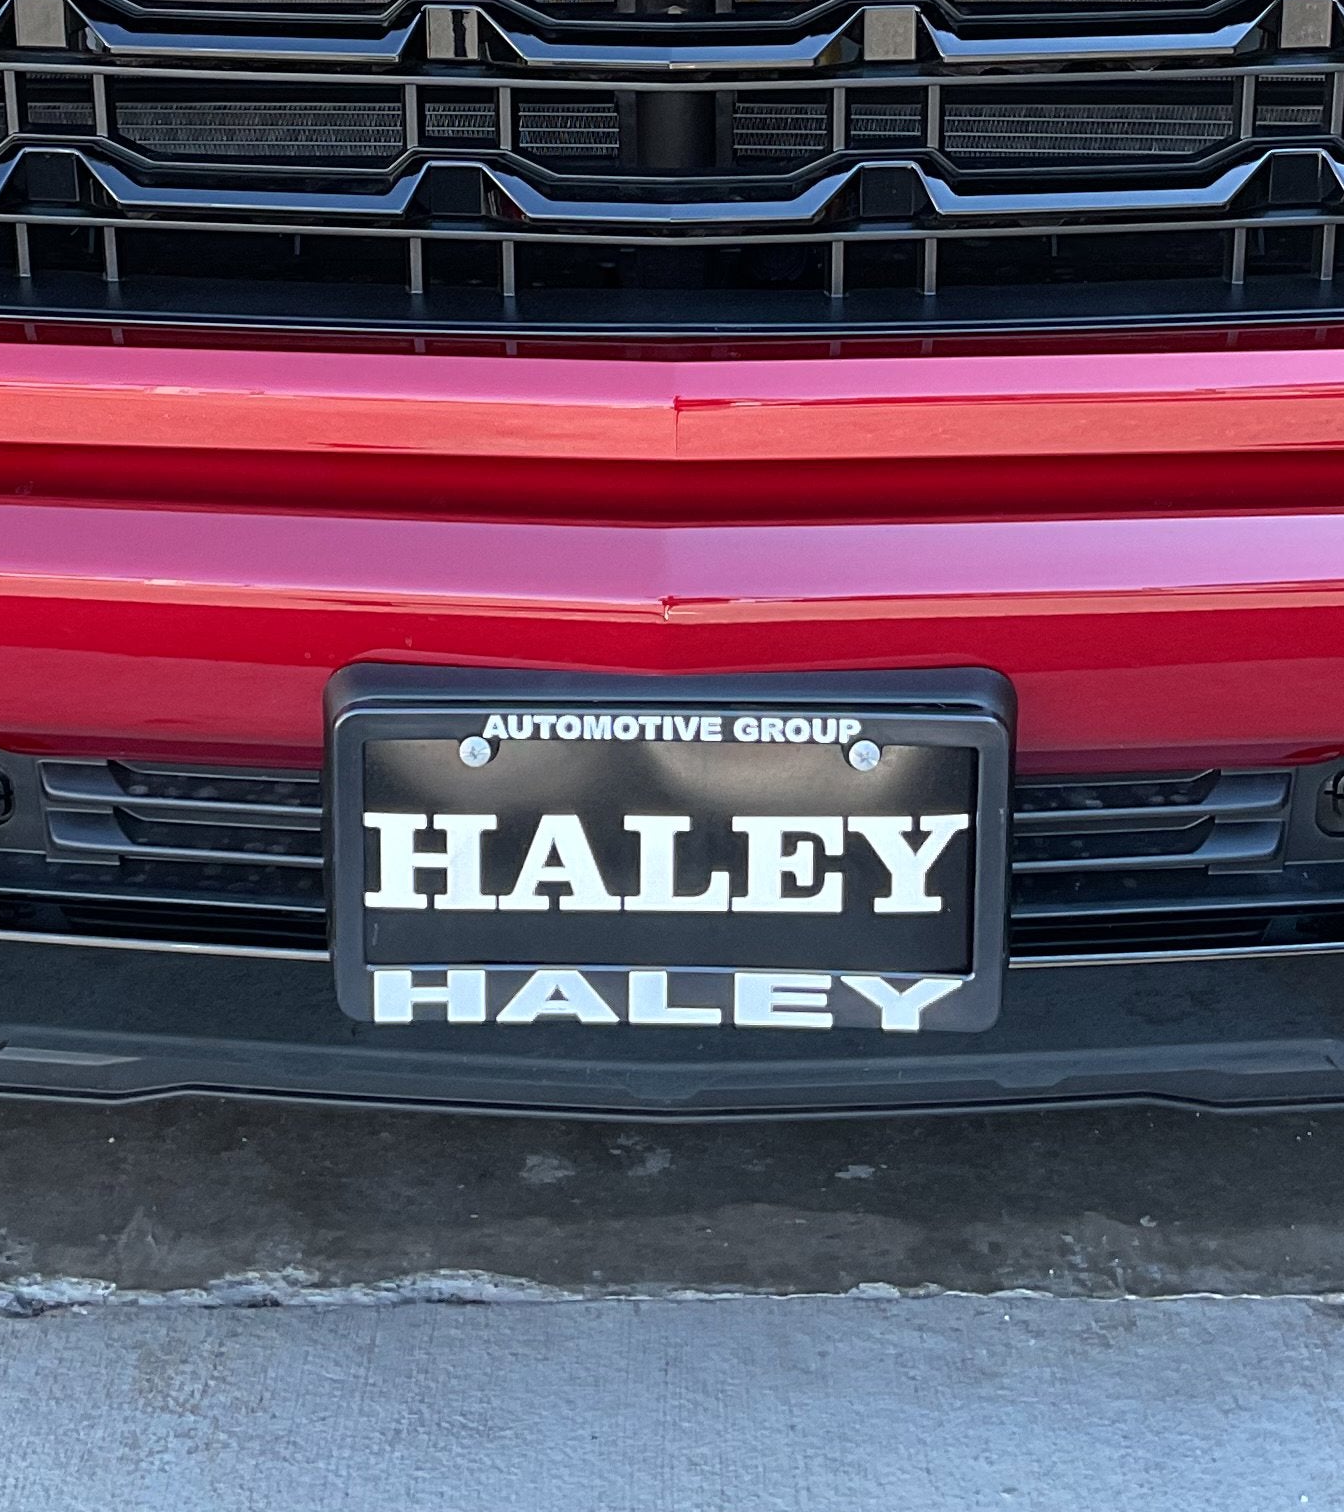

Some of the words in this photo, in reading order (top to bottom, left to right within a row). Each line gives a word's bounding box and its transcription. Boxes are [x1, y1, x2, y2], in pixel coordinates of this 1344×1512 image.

[482, 714, 723, 742] AUTOMOTIVE
[733, 716, 862, 744] GROUP
[363, 812, 969, 913] HALEY
[372, 967, 965, 1032] HALEY
